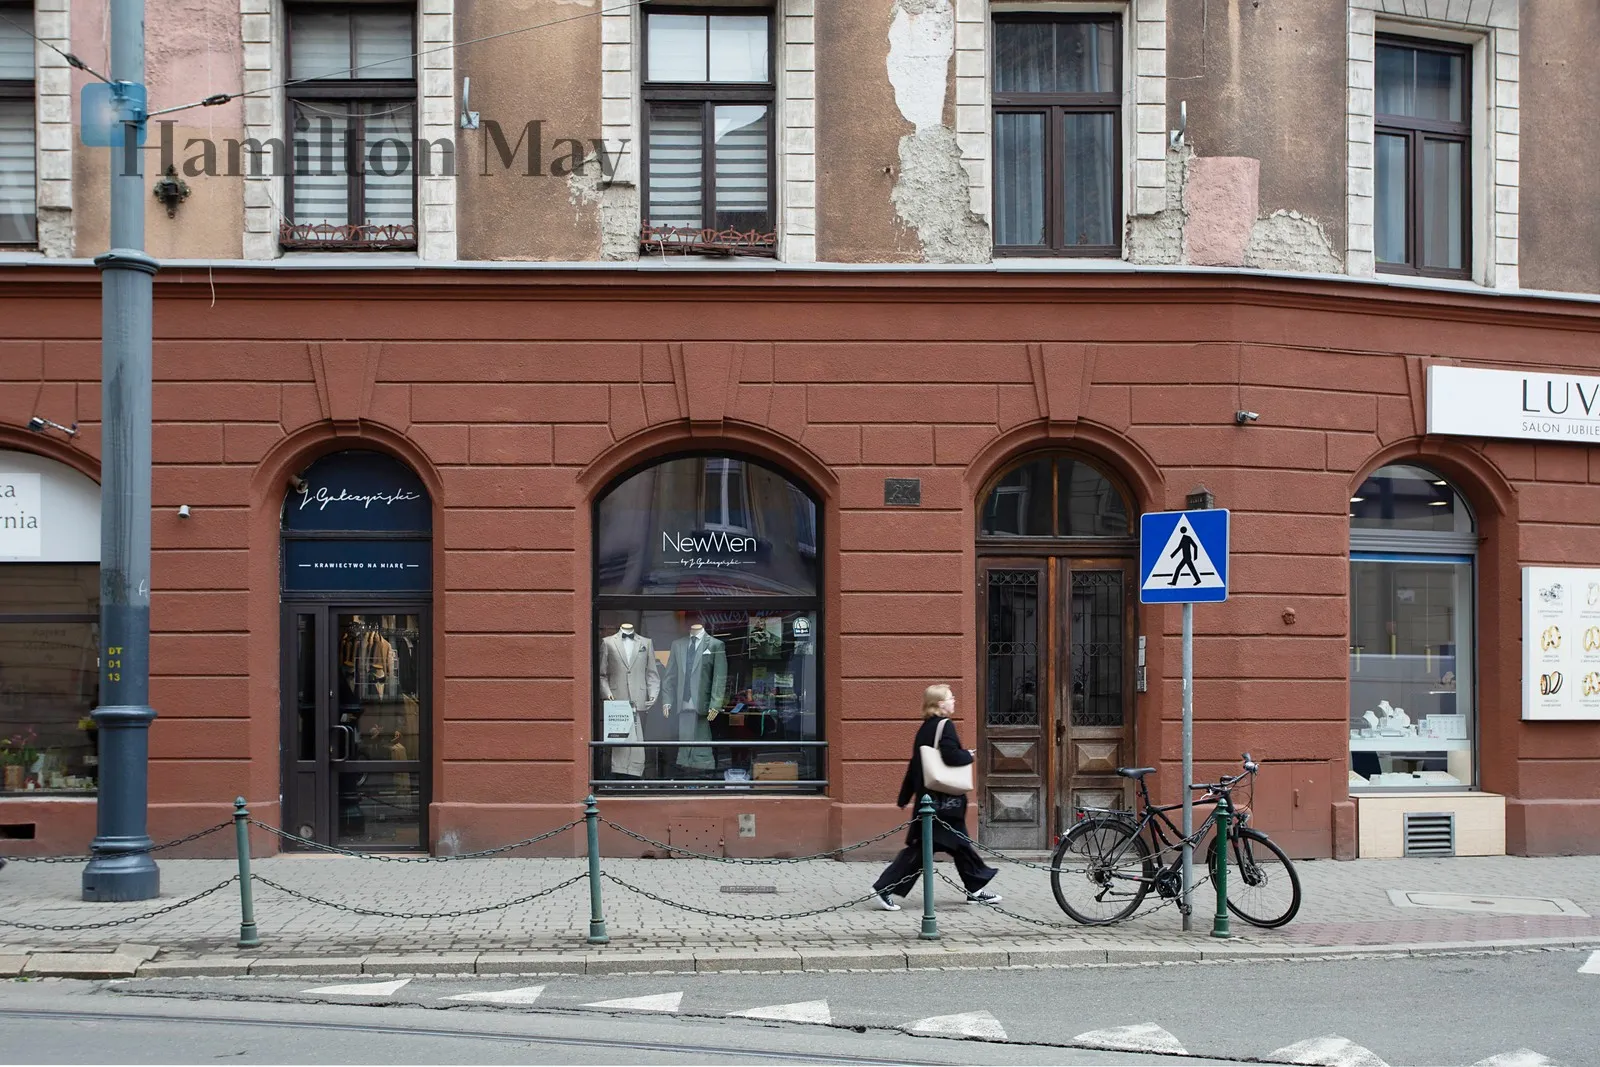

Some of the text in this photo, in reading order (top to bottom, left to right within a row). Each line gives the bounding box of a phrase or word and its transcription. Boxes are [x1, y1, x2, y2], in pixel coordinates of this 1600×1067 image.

[1522, 379, 1600, 416] LUV
[1522, 421, 1600, 436] SALON JUBILE
[0, 510, 38, 529] nia
[662, 531, 757, 552] NewMen
[108, 647, 123, 655] DT
[108, 659, 121, 668] 01
[108, 672, 121, 681] 13
